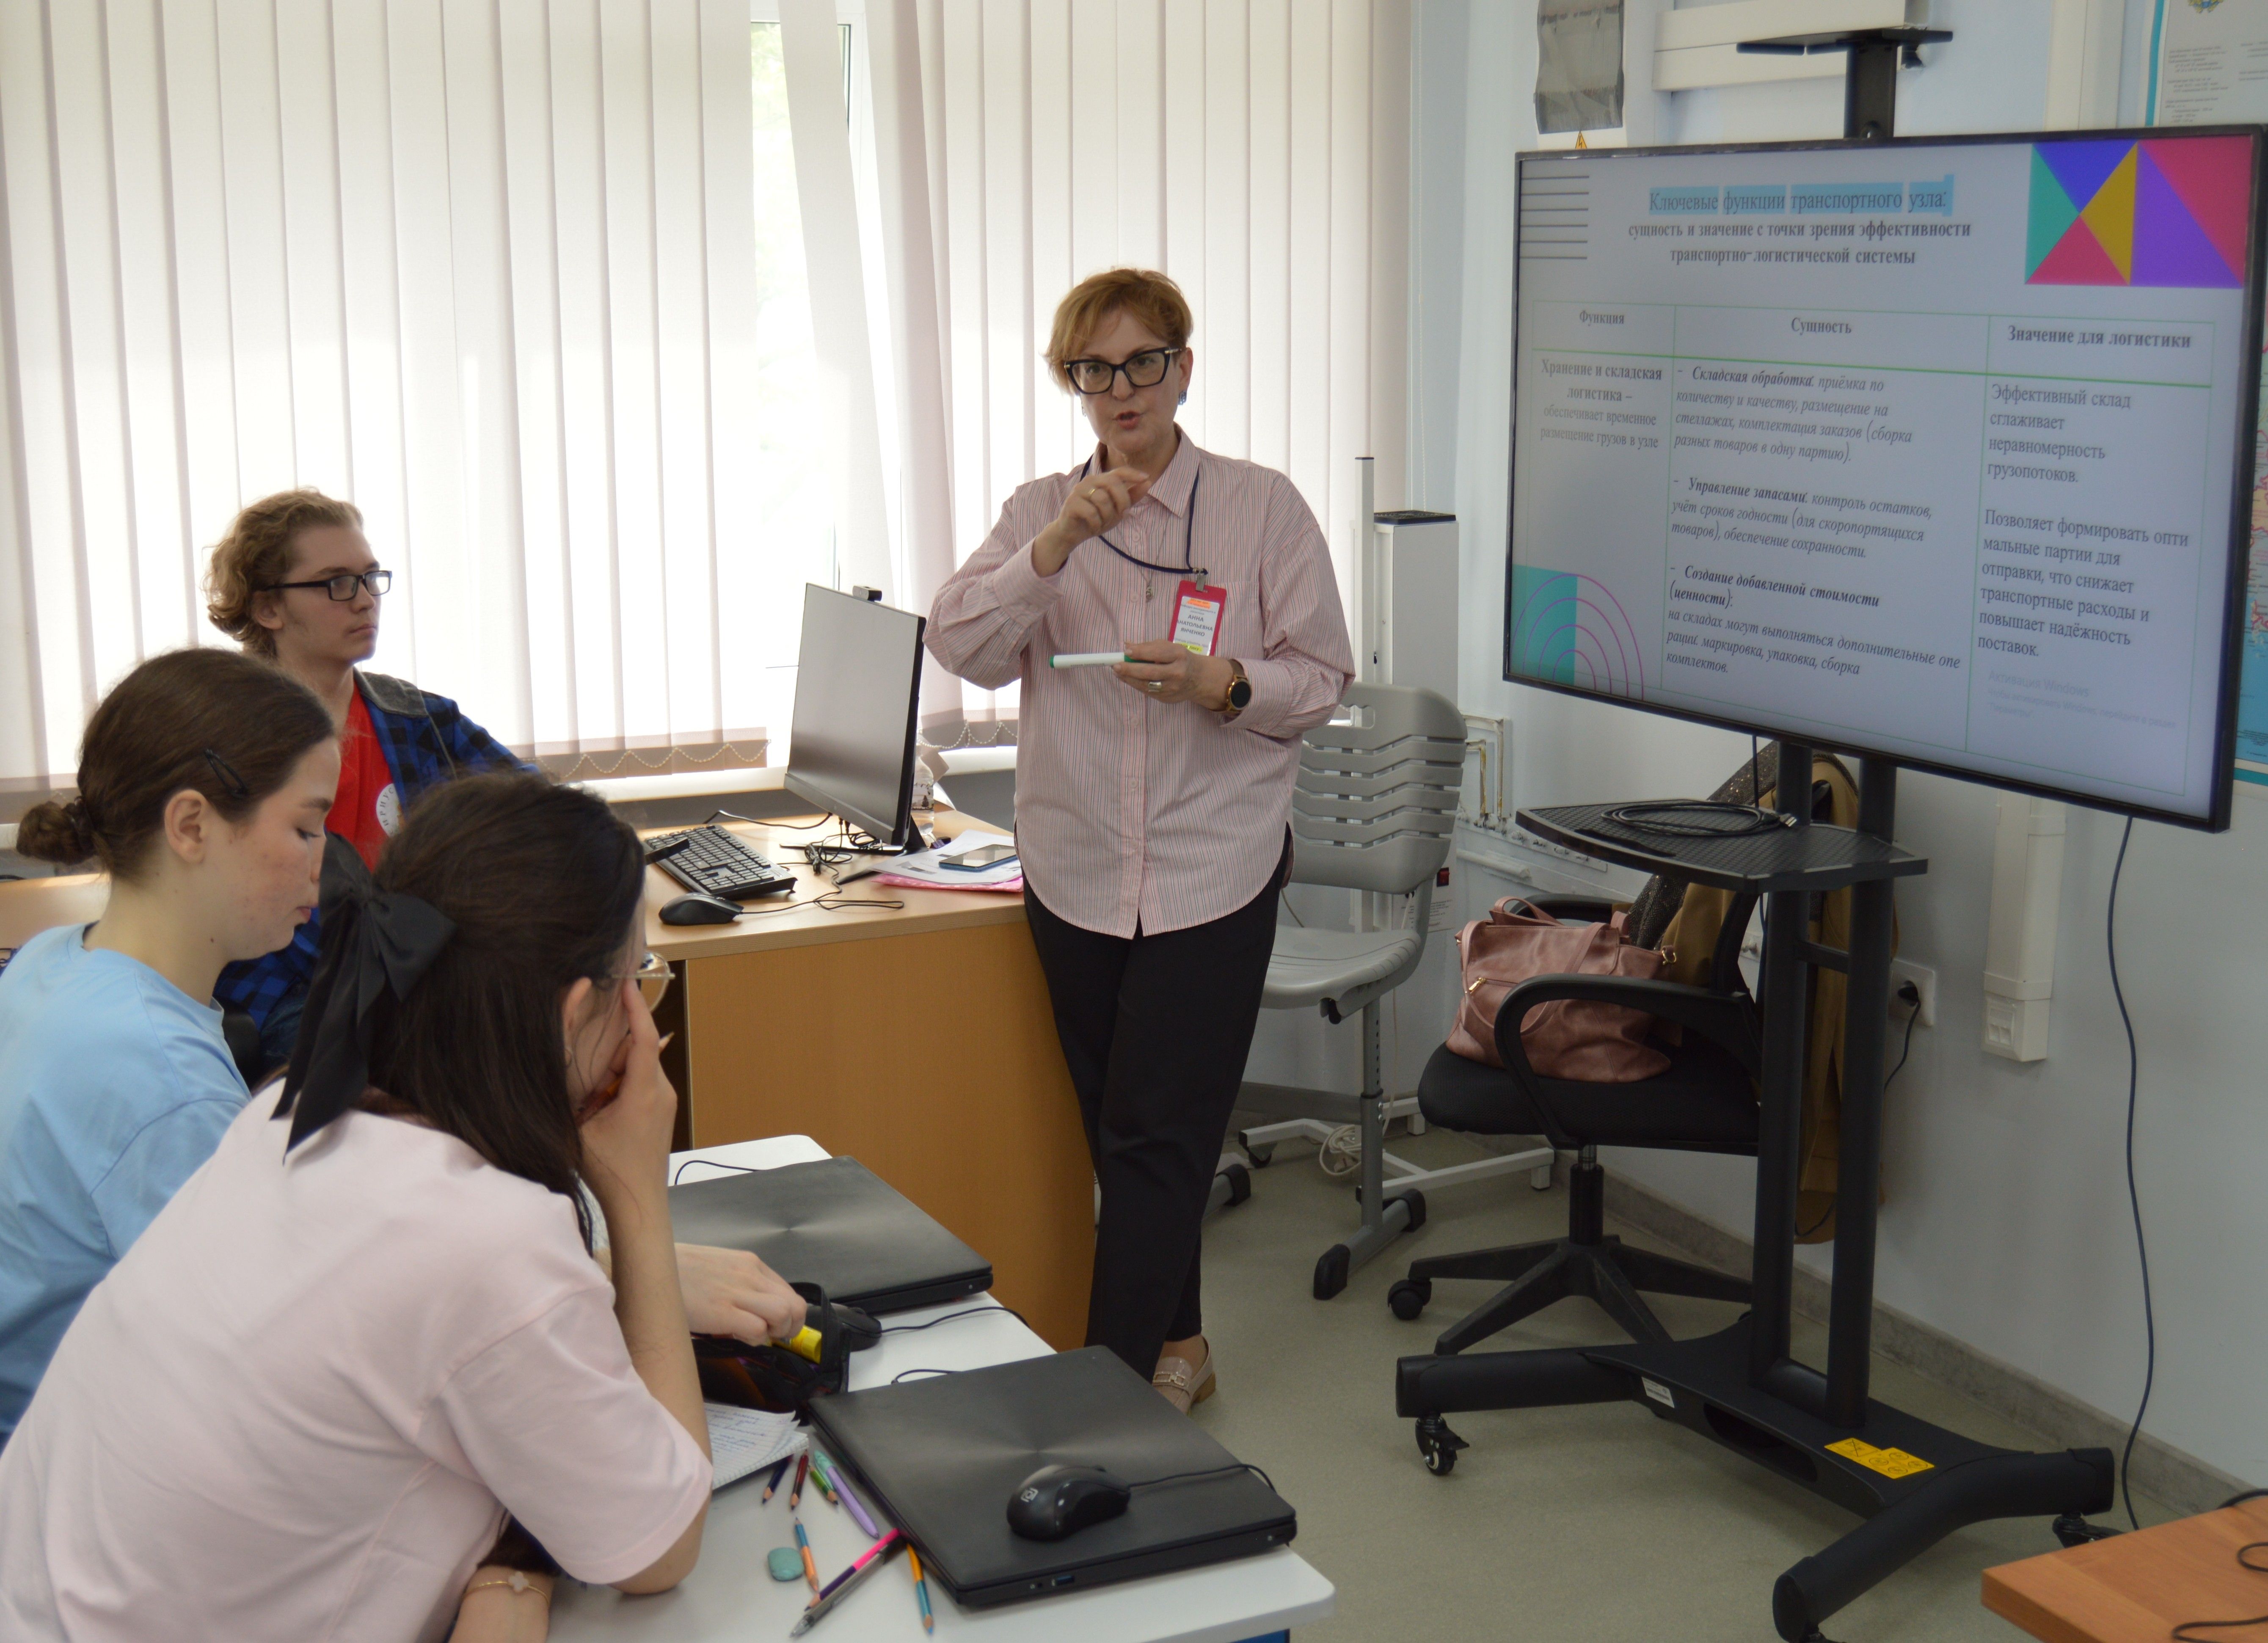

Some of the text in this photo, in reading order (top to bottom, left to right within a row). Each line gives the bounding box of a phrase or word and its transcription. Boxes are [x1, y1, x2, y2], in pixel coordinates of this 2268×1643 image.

[1649, 190, 1947, 214] Ключевые функции транспортного узла:
[1628, 221, 1972, 240] сущность и значение с точки зрения эффективности
[1855, 251, 1916, 264] системы
[1579, 310, 1625, 326] Функция
[1791, 317, 1853, 336] Сущность
[2008, 325, 2192, 348] Значение для логистики
[1542, 359, 1663, 381] Хранение и складская
[1692, 366, 1748, 383] Складская
[1818, 375, 1867, 391] приёмка
[1869, 380, 1885, 392] по
[1567, 388, 1622, 402] логистика
[1676, 391, 1889, 416] количеству и качеству, размещение на
[1992, 384, 2132, 410] Эффективный склад
[1544, 404, 1657, 426] обеспечивает временное
[1990, 413, 2066, 430] сглаживает
[1540, 428, 1659, 450] размещение грузов в узле
[1676, 414, 1913, 444] стеллажах, комплектация заказов (сборка
[1673, 436, 1851, 464] разных товаров в одну партию).
[1988, 438, 2107, 460] неравномерность
[1987, 463, 2079, 482] грузопотоков.
[1688, 477, 1751, 497] Управление
[1811, 494, 1867, 511] контроль
[1869, 501, 1932, 520] остатков,
[1671, 499, 1925, 542] учёт сроков годности (для скоропортящихся
[1984, 508, 2054, 532] Позволяет
[2057, 517, 2150, 543] формировать
[1671, 521, 1866, 558] товаров), обеспечение сохранности.
[1983, 538, 2122, 566] мальные партии для
[1684, 565, 1734, 585] Создание
[1736, 573, 1807, 596] добавленной
[1809, 587, 1880, 607] стоимости
[1981, 563, 2135, 594] отправки, что снижает
[1669, 579, 1733, 609] (ценности):
[1980, 587, 2151, 622] транспортные расходы и
[1180, 627, 1205, 637] ЯНЧЕНКО
[1668, 610, 1680, 620] на
[1683, 613, 1723, 628] складах
[1725, 620, 1759, 636] могут
[1761, 626, 1834, 647] выполняться
[1837, 638, 1936, 664] дополнительные
[1979, 612, 2132, 645] повышает надёжность
[1701, 638, 1764, 660] маркировка,
[1767, 649, 1818, 670] упаковка,
[1821, 656, 1860, 676] сборка
[1978, 637, 2039, 657] поставок.
[1666, 653, 1728, 673] комплектов.
[2043, 678, 2090, 697] Windows
